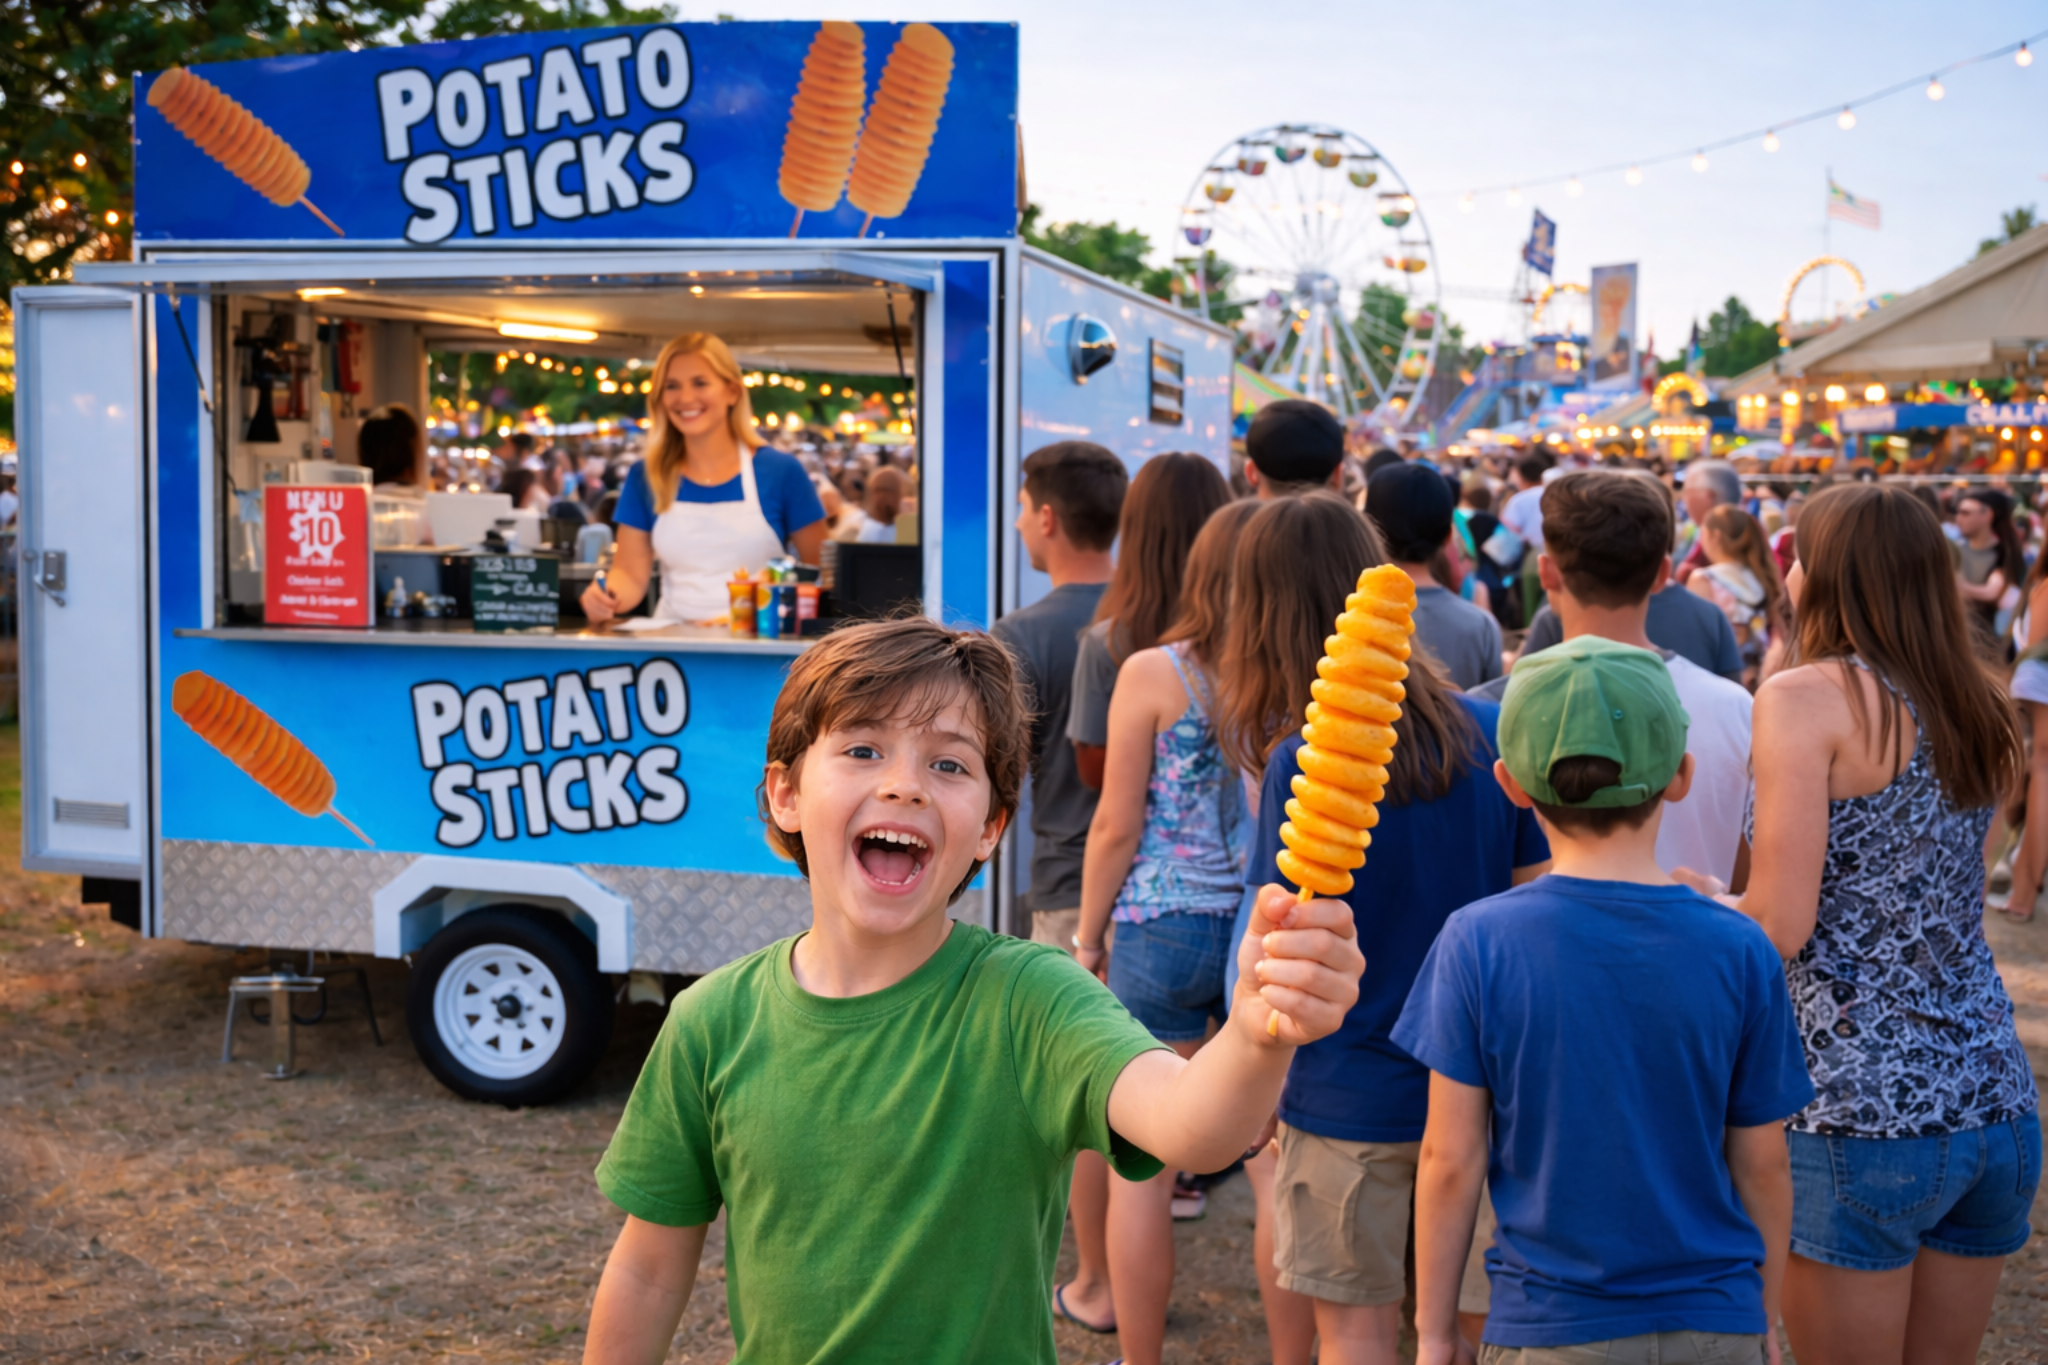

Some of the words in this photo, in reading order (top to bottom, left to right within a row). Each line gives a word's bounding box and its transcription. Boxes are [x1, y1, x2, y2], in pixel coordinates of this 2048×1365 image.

[376, 26, 692, 163] POTATO
[401, 119, 695, 245] STICKS
[411, 657, 690, 770] POTATO
[430, 744, 690, 849] STICKS
